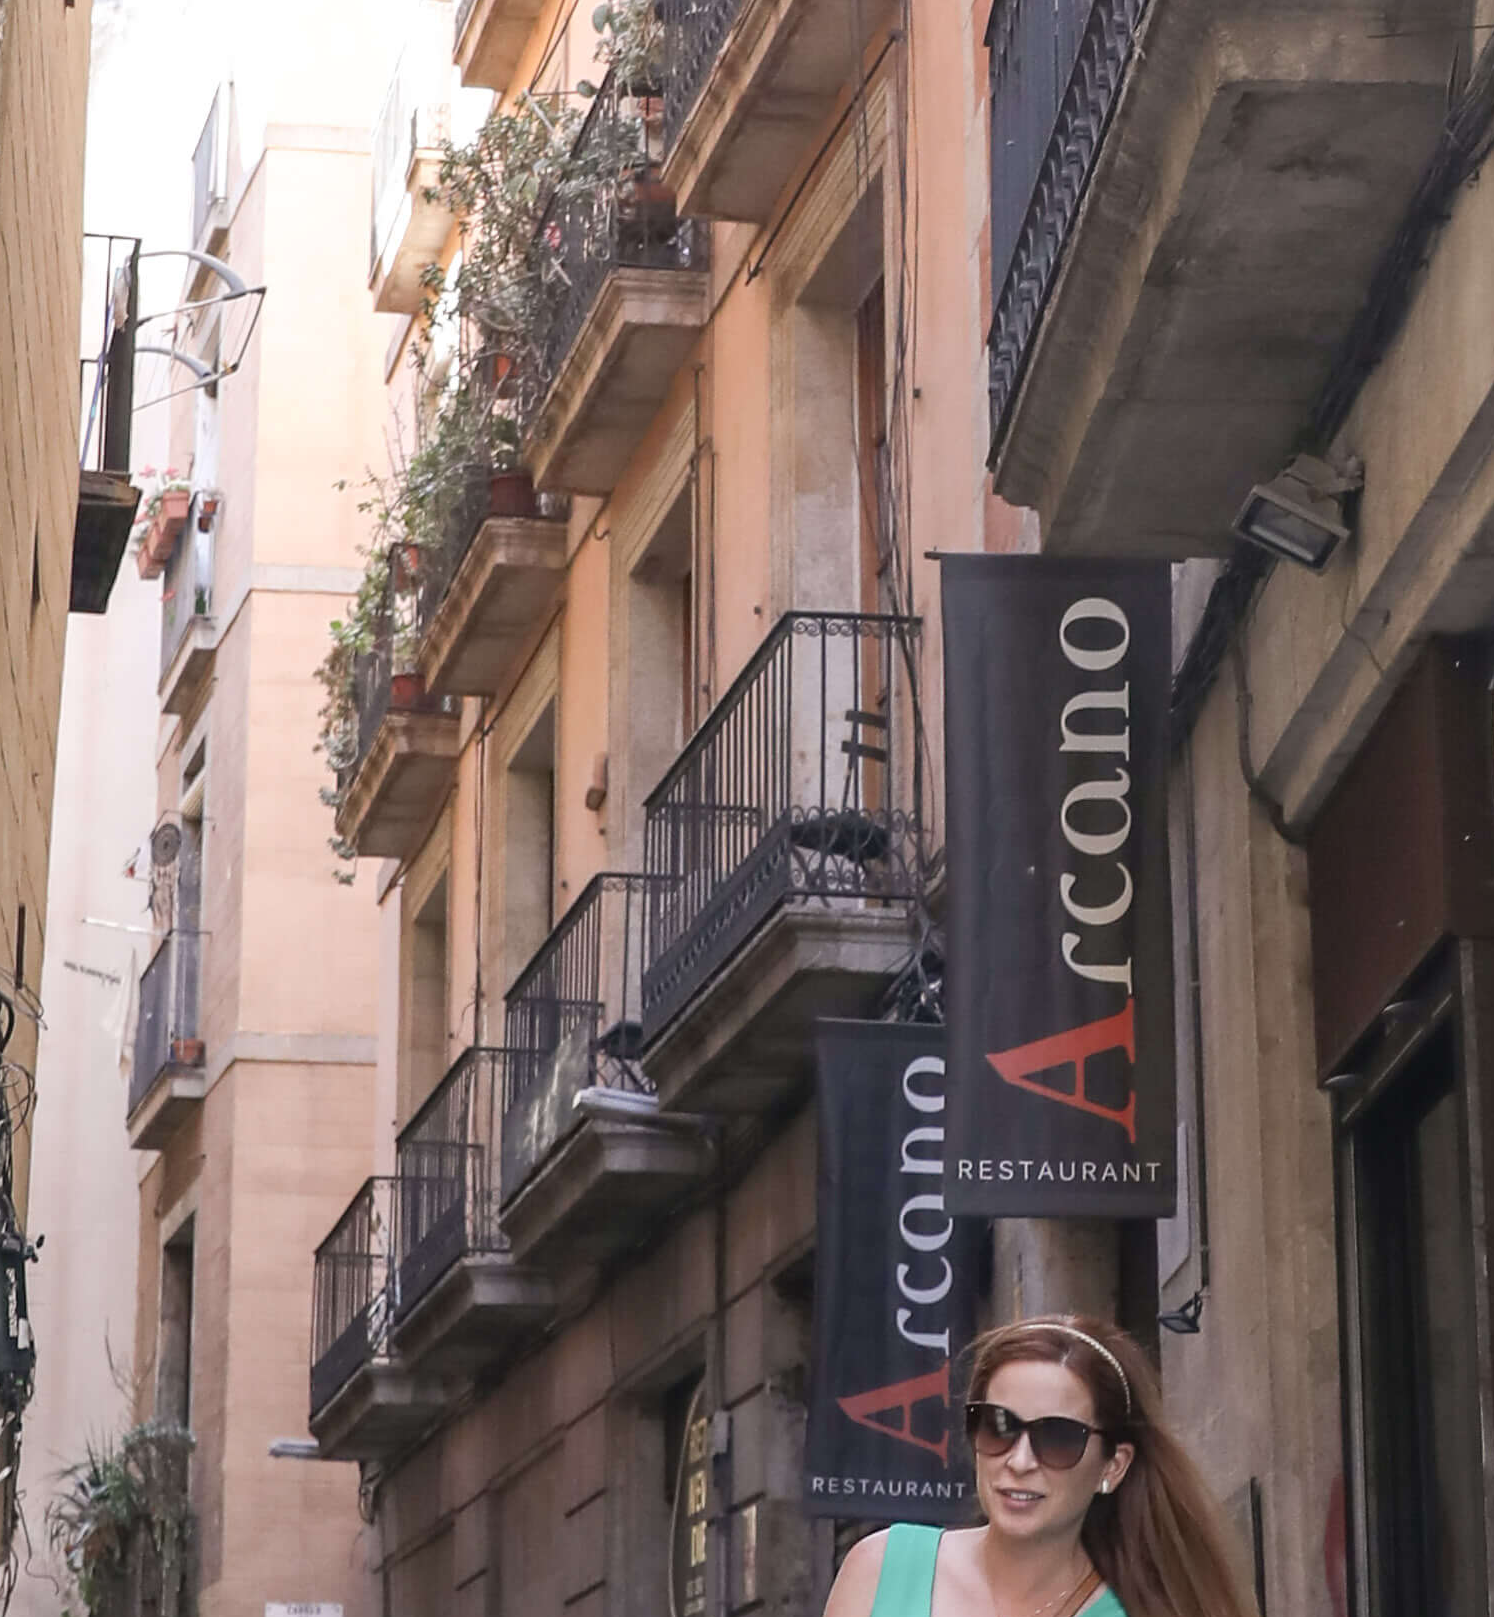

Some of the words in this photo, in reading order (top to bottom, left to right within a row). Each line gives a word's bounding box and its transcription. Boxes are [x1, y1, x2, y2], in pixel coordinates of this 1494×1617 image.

[985, 596, 1136, 1145] Arcano
[957, 1159, 1161, 1182] RESTAURANT
[811, 1476, 966, 1499] RESTAURANT
